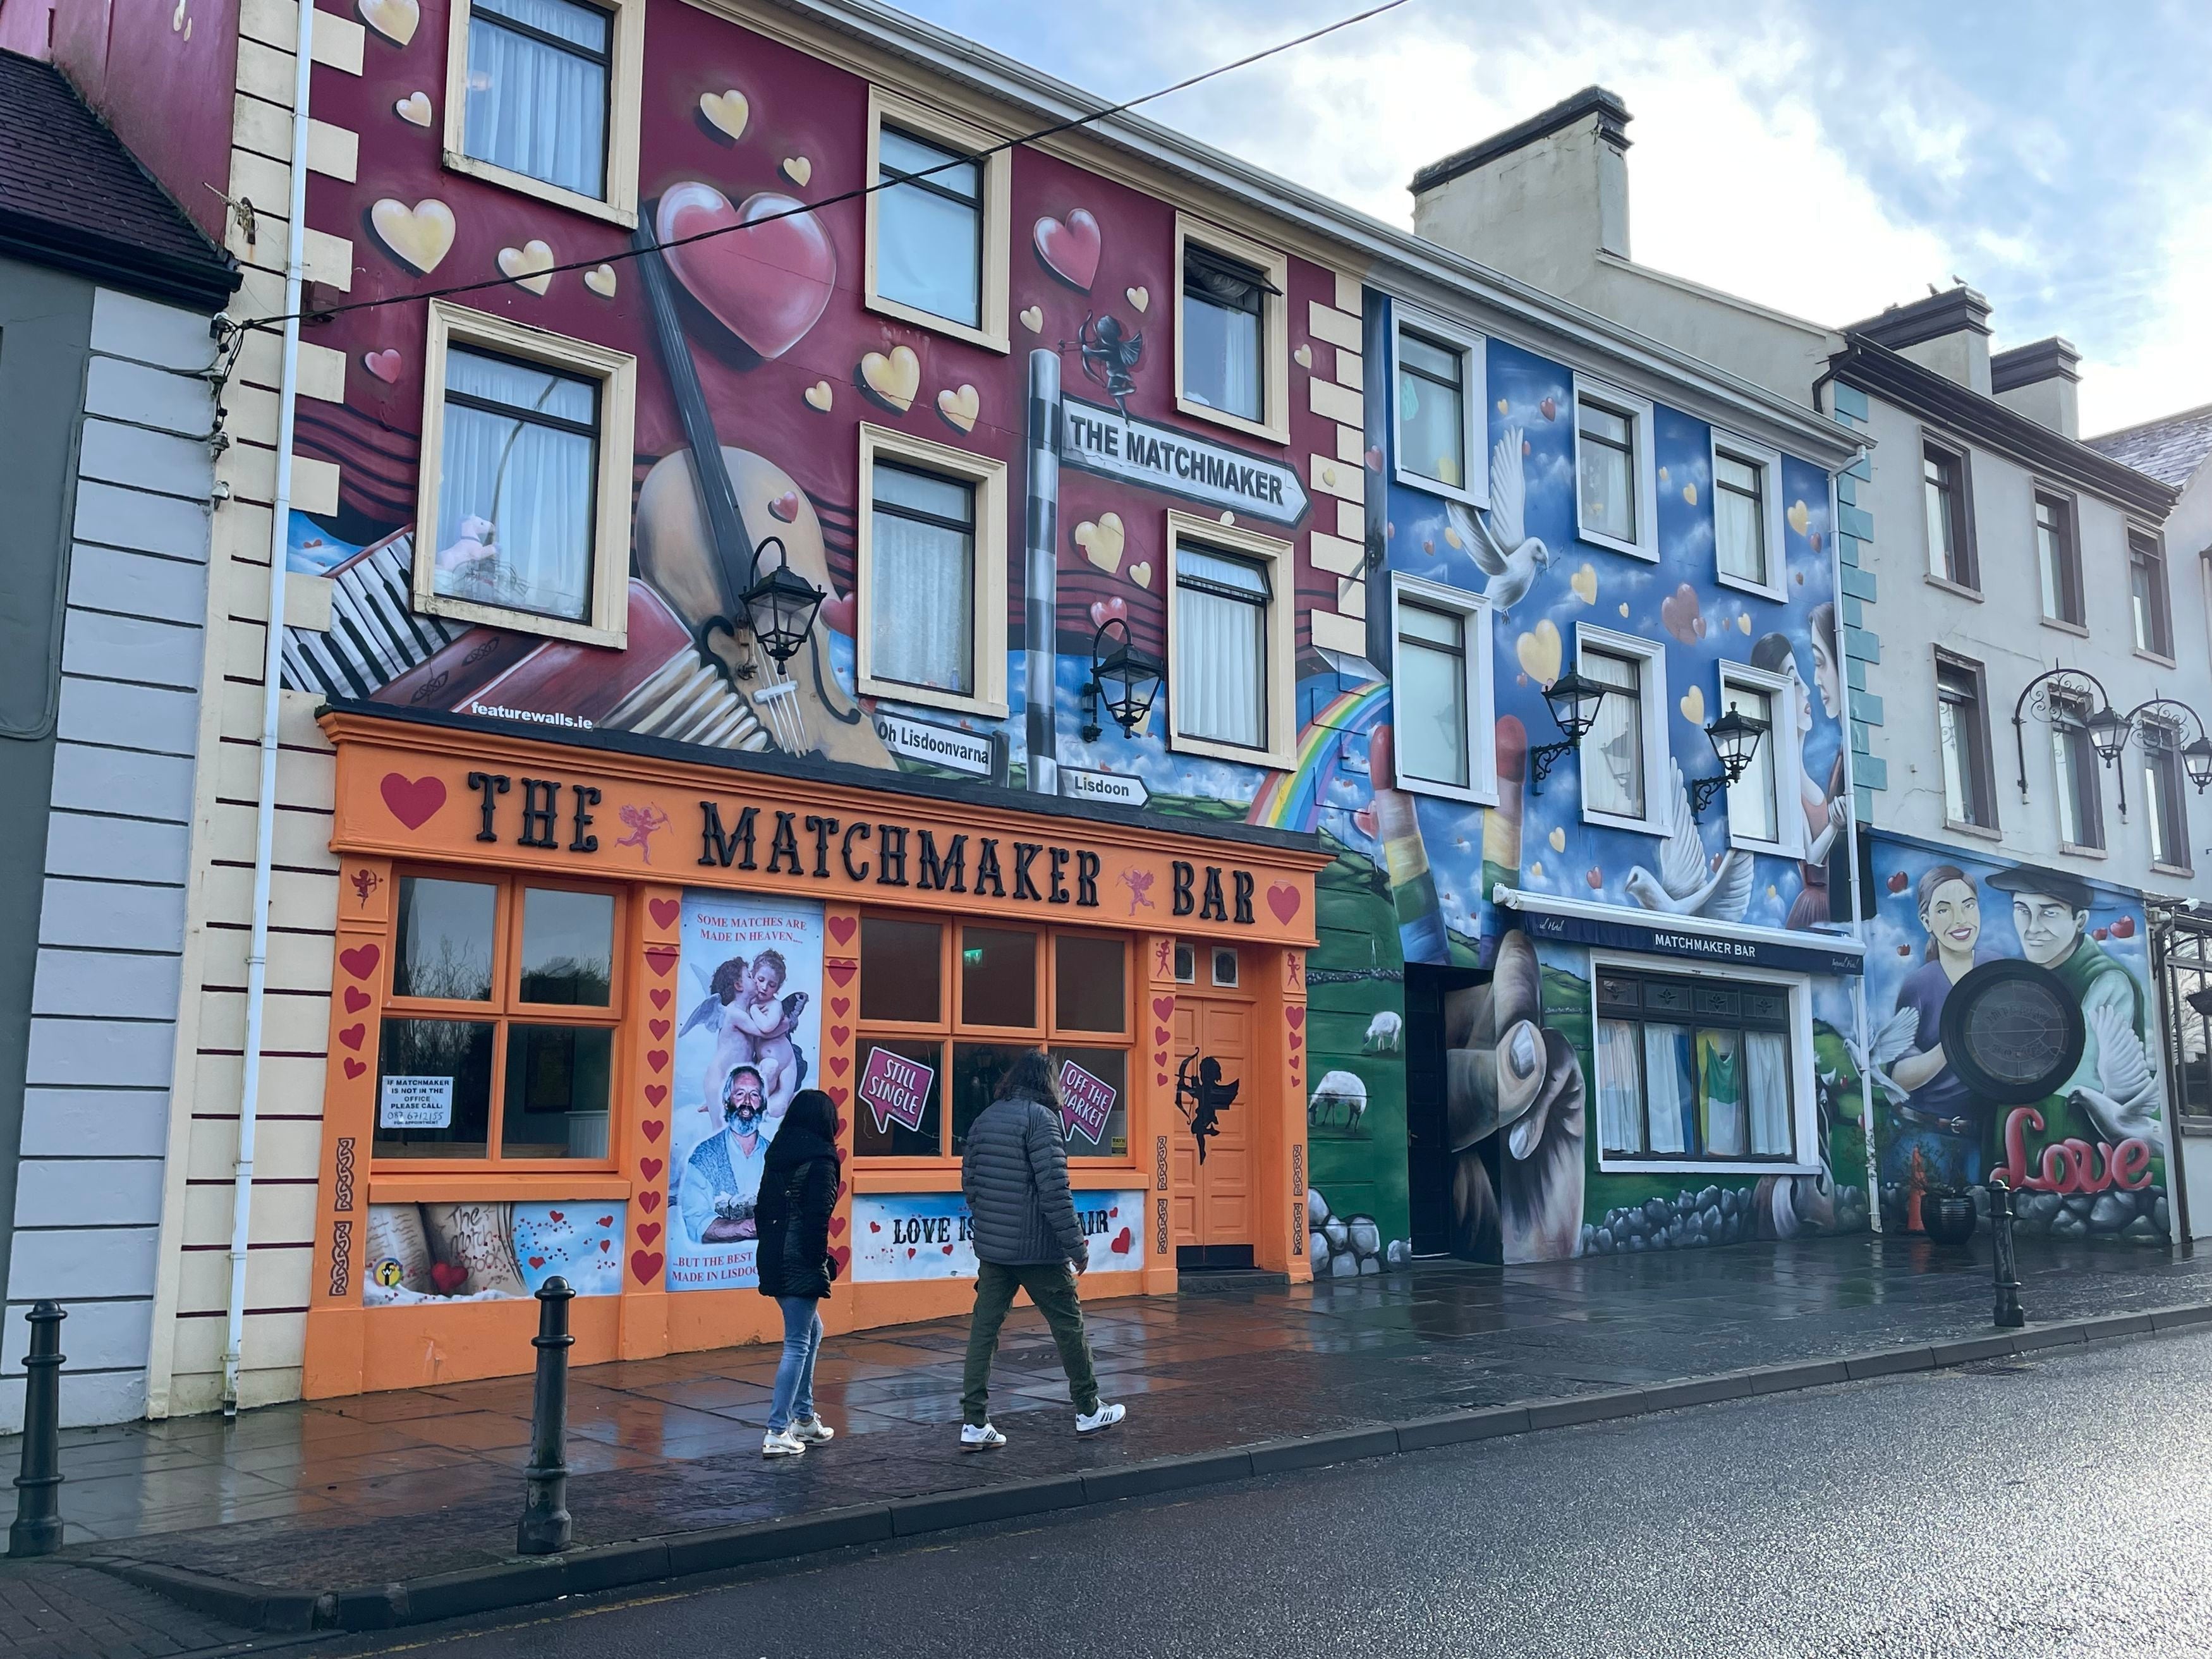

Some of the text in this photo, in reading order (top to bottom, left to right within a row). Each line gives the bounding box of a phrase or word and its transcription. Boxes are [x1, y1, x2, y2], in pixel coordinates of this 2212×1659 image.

[1071, 415, 1285, 506] THE MATCHMAKER
[471, 702, 593, 729] featurewalls.ie
[878, 721, 989, 765] Oh Lisdoonvarna
[1074, 776, 1130, 797] Lisdoon
[468, 771, 1256, 924] THE MATCHMAKER BAR
[697, 913, 807, 932] SOME MATCHES ARE
[700, 929, 732, 942] MADE
[736, 933, 746, 941] IN
[1655, 934, 1756, 958] MATCHMAKER BAR
[884, 1059, 916, 1090] STILL
[868, 1076, 920, 1115] SINGLE
[1066, 1069, 1110, 1112] OFF THE
[1062, 1086, 1104, 1128] MARKET
[1990, 1108, 2153, 1194] Love
[444, 1205, 482, 1231] The
[893, 1217, 951, 1244] LOVE
[703, 1256, 724, 1267] THE
[727, 1251, 753, 1264] BEST
[672, 1270, 703, 1282] MADE
[707, 1271, 719, 1280] IN
